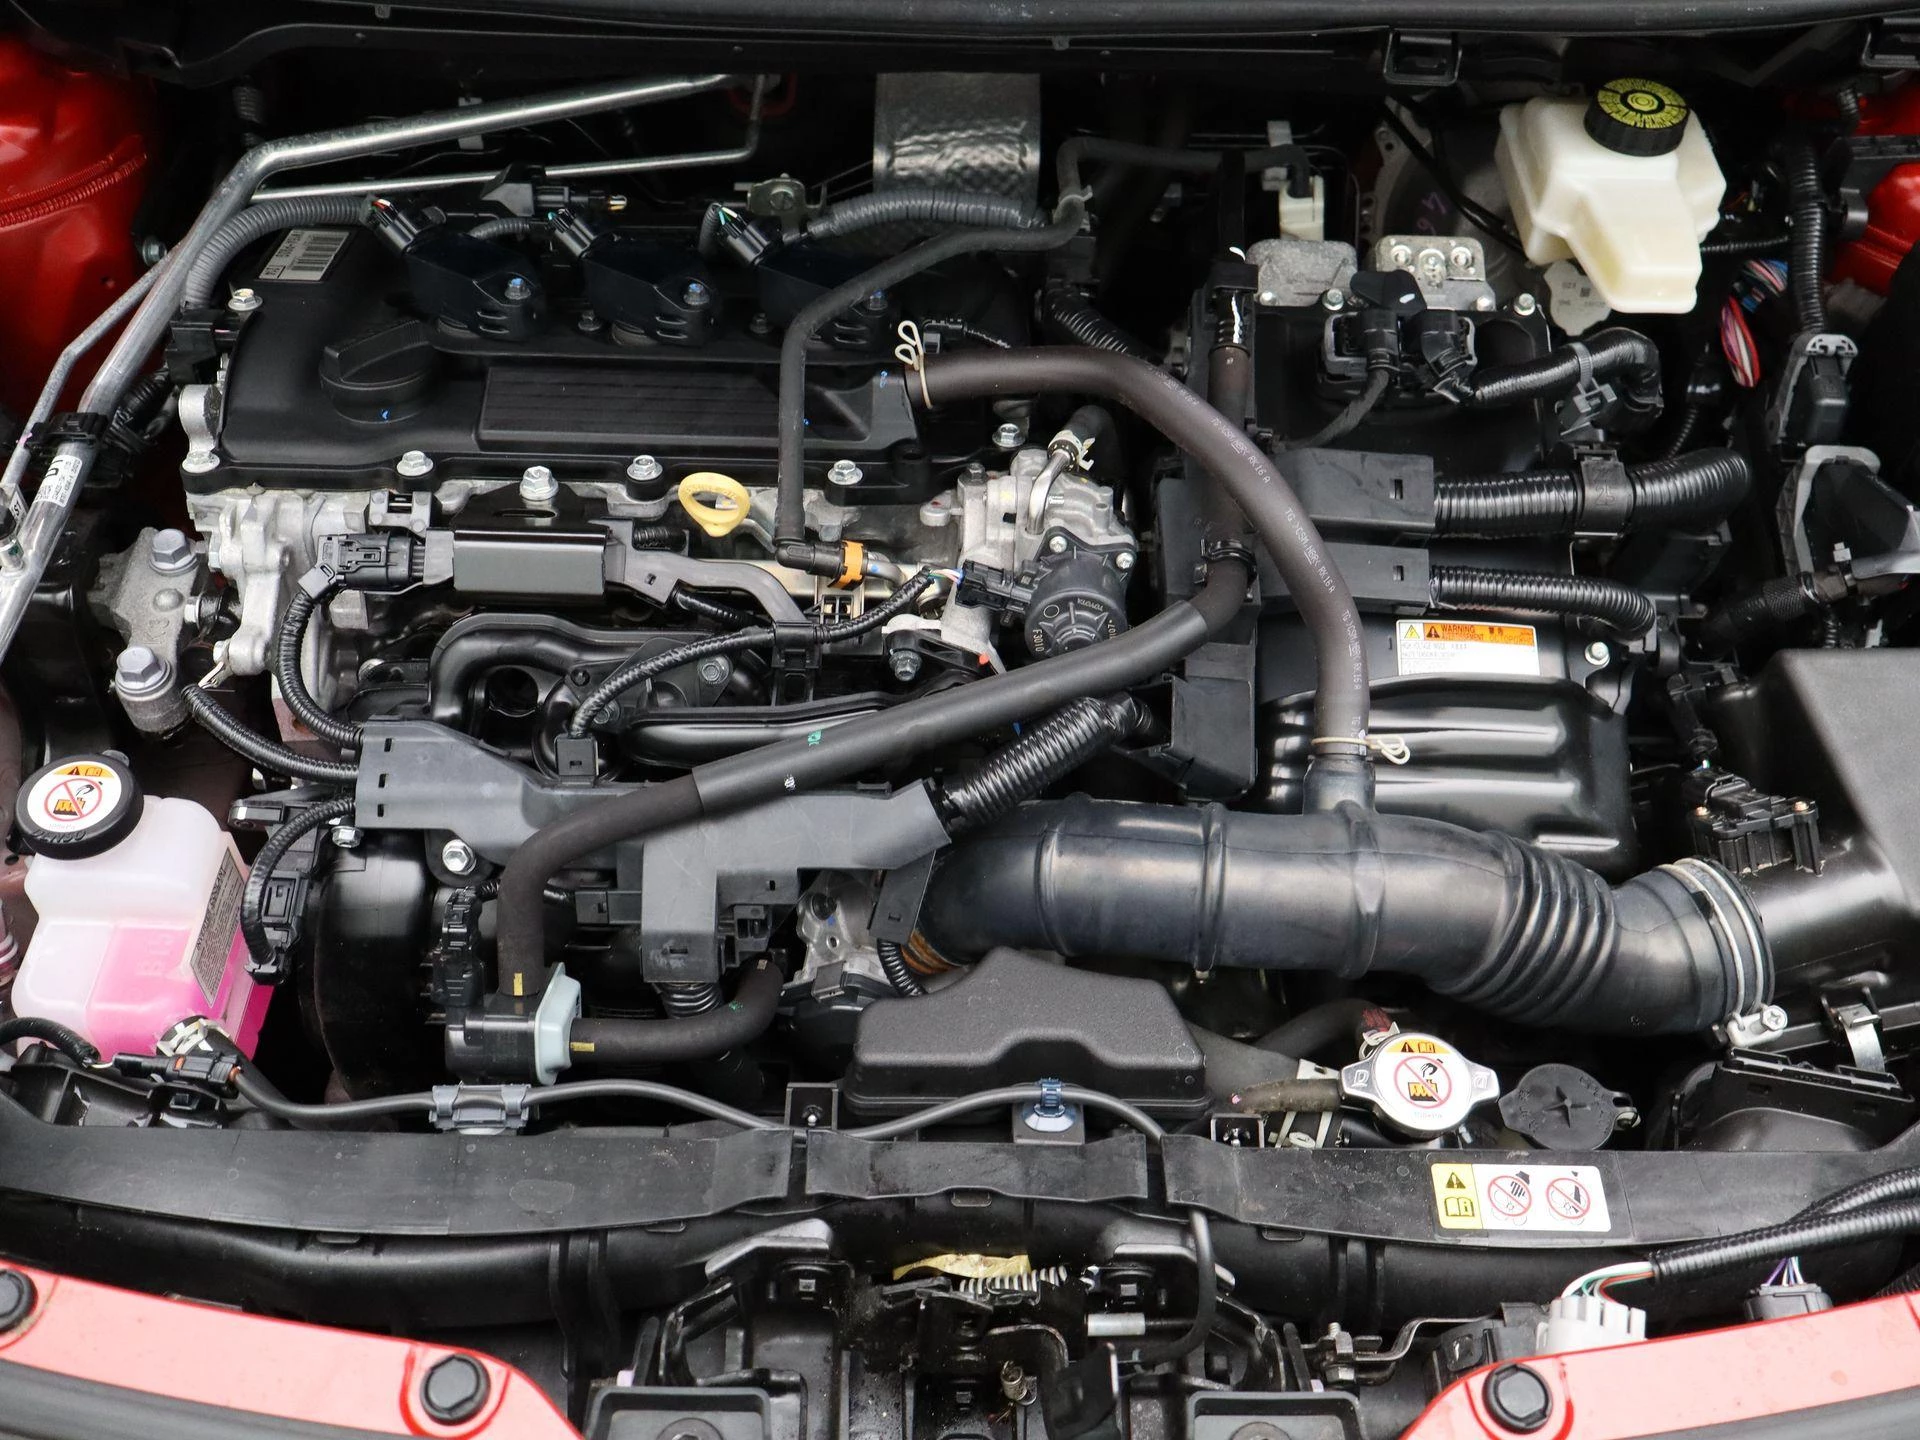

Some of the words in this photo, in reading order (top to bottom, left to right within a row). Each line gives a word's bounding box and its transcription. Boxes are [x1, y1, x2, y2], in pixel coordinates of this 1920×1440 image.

[1285, 507, 1296, 522] TG
[1318, 566, 1333, 587] RK16
[1328, 585, 1336, 593] A
[1032, 629, 1045, 652] F3010
[1441, 624, 1475, 634] WARNING
